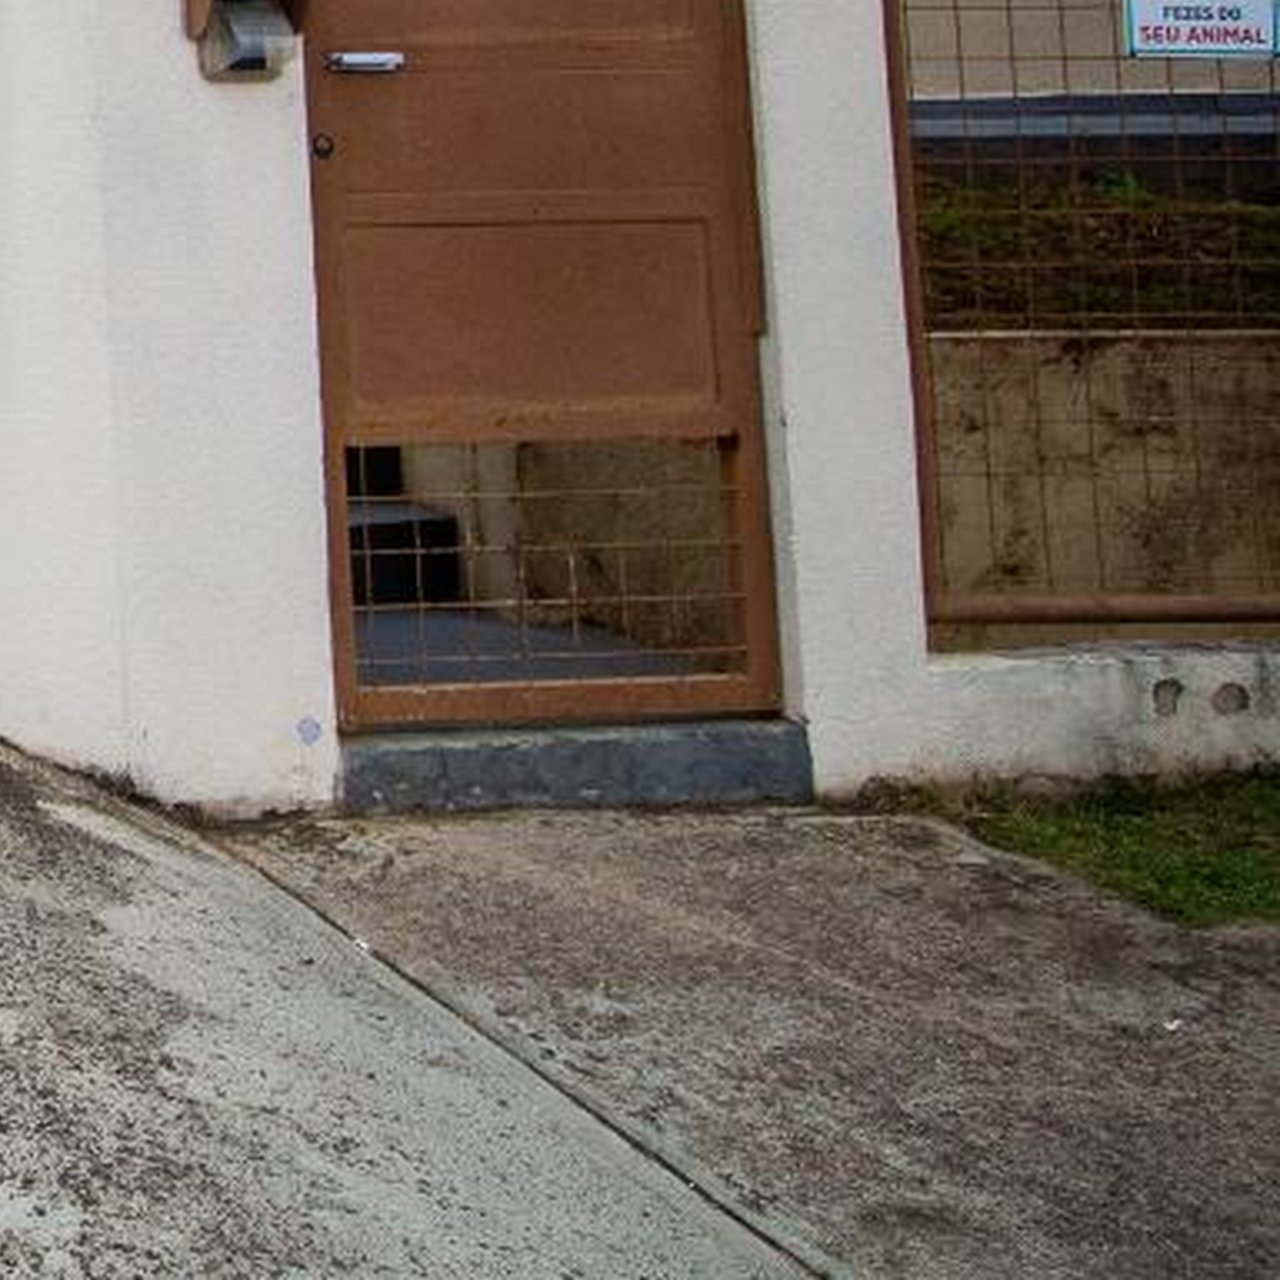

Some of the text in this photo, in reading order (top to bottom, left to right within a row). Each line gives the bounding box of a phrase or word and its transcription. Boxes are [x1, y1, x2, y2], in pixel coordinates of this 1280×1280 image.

[1162, 6, 1242, 21] FEZES DO
[1140, 25, 1267, 45] SEU ANIMAL
